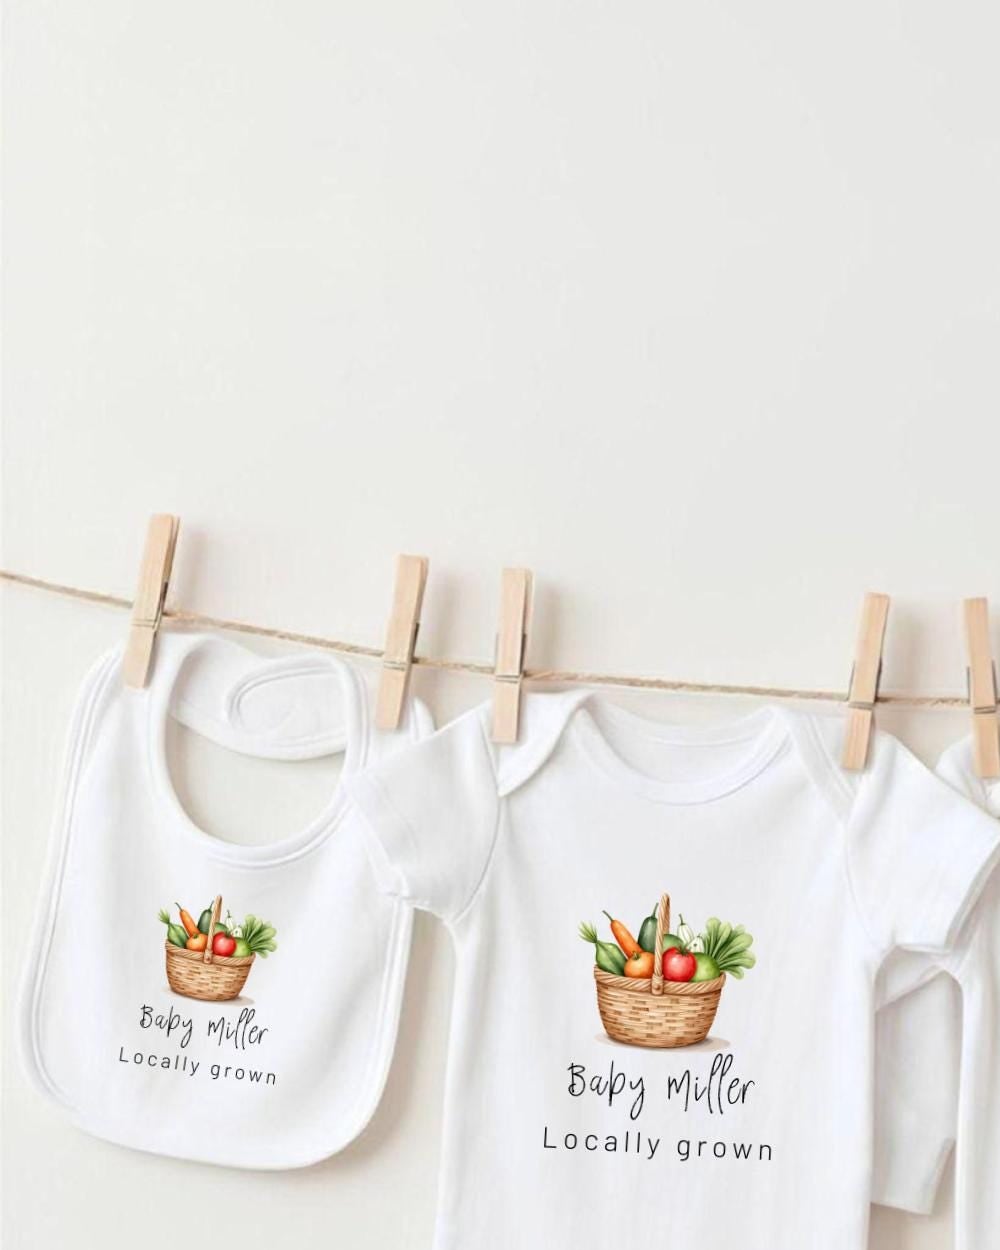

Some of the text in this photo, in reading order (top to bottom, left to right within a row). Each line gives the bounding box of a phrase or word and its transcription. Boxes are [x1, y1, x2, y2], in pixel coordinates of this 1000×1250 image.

[139, 1004, 268, 1050] Baby Miller
[119, 1047, 276, 1086] Locally grown
[567, 1053, 756, 1121] Baby Miller
[543, 1126, 772, 1162] Locally grown
